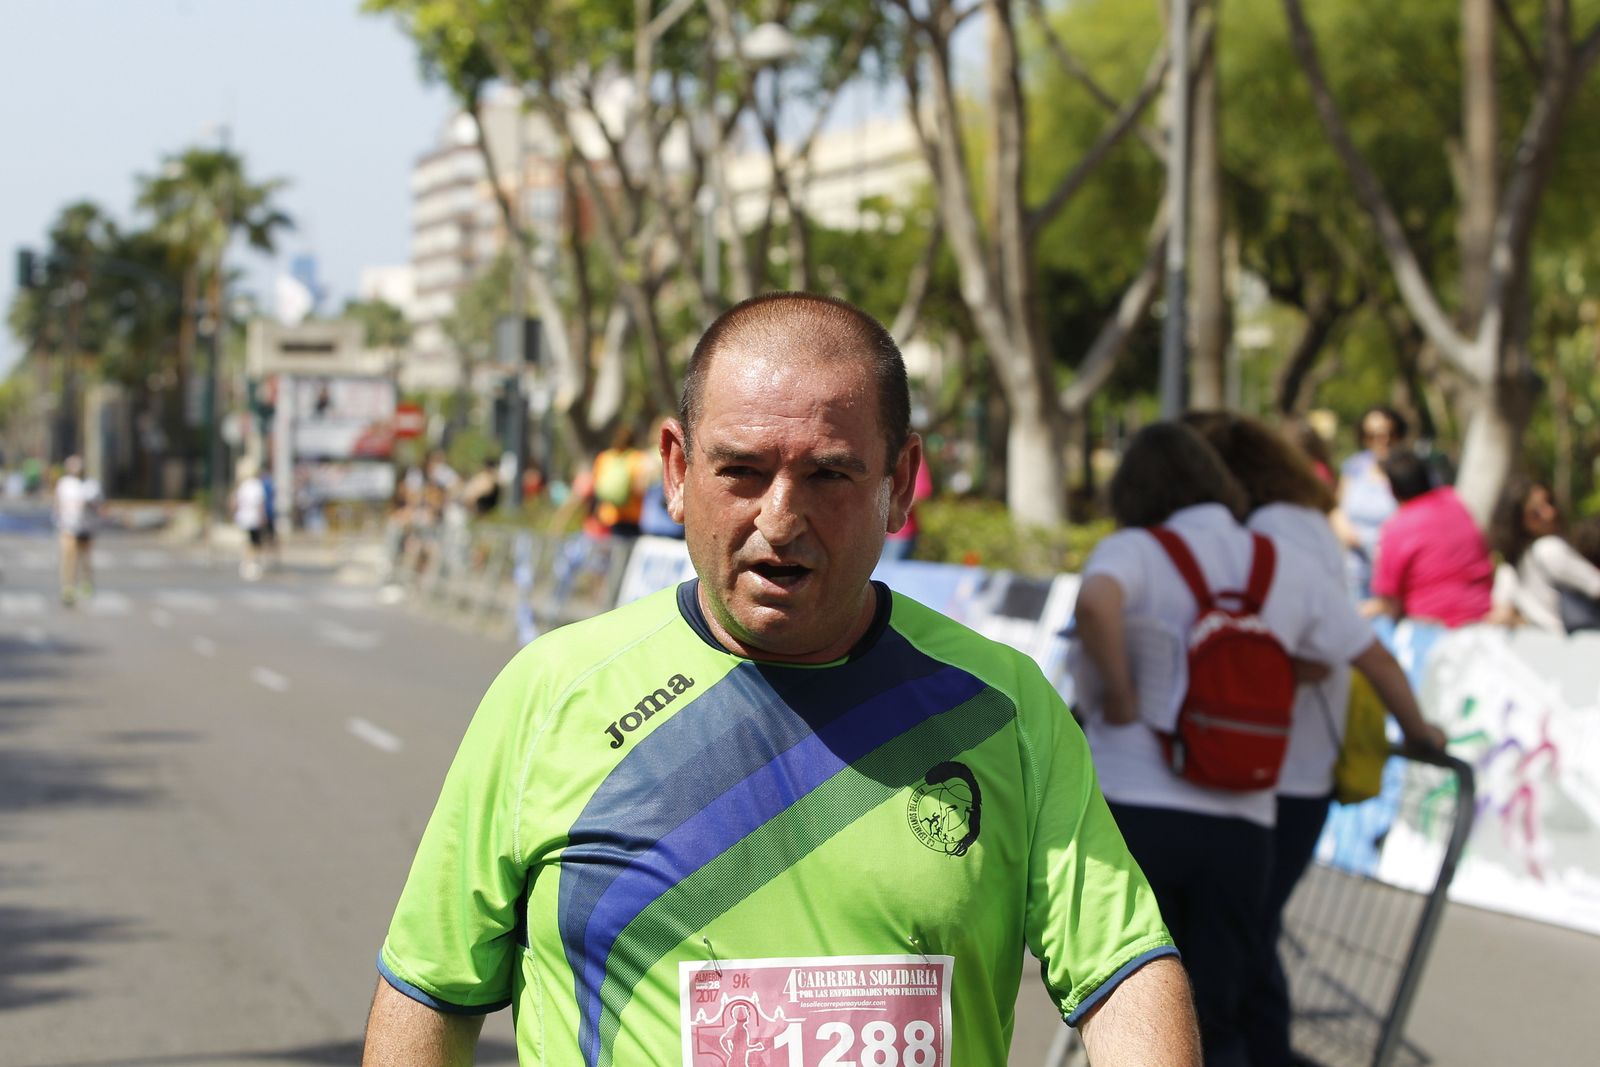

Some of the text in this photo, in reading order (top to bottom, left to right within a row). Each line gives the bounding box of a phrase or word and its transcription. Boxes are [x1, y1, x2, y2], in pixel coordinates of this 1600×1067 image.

[604, 673, 695, 750] Joma
[708, 981, 720, 990] 28
[732, 973, 751, 989] 9k
[797, 970, 867, 988] CARRERA
[869, 969, 938, 986] SOLIDARIA
[695, 989, 719, 1003] 2017
[800, 987, 938, 998] POR LAS ENFERMEDADES POCO FRECUENTES
[773, 1020, 937, 1067] 1288
